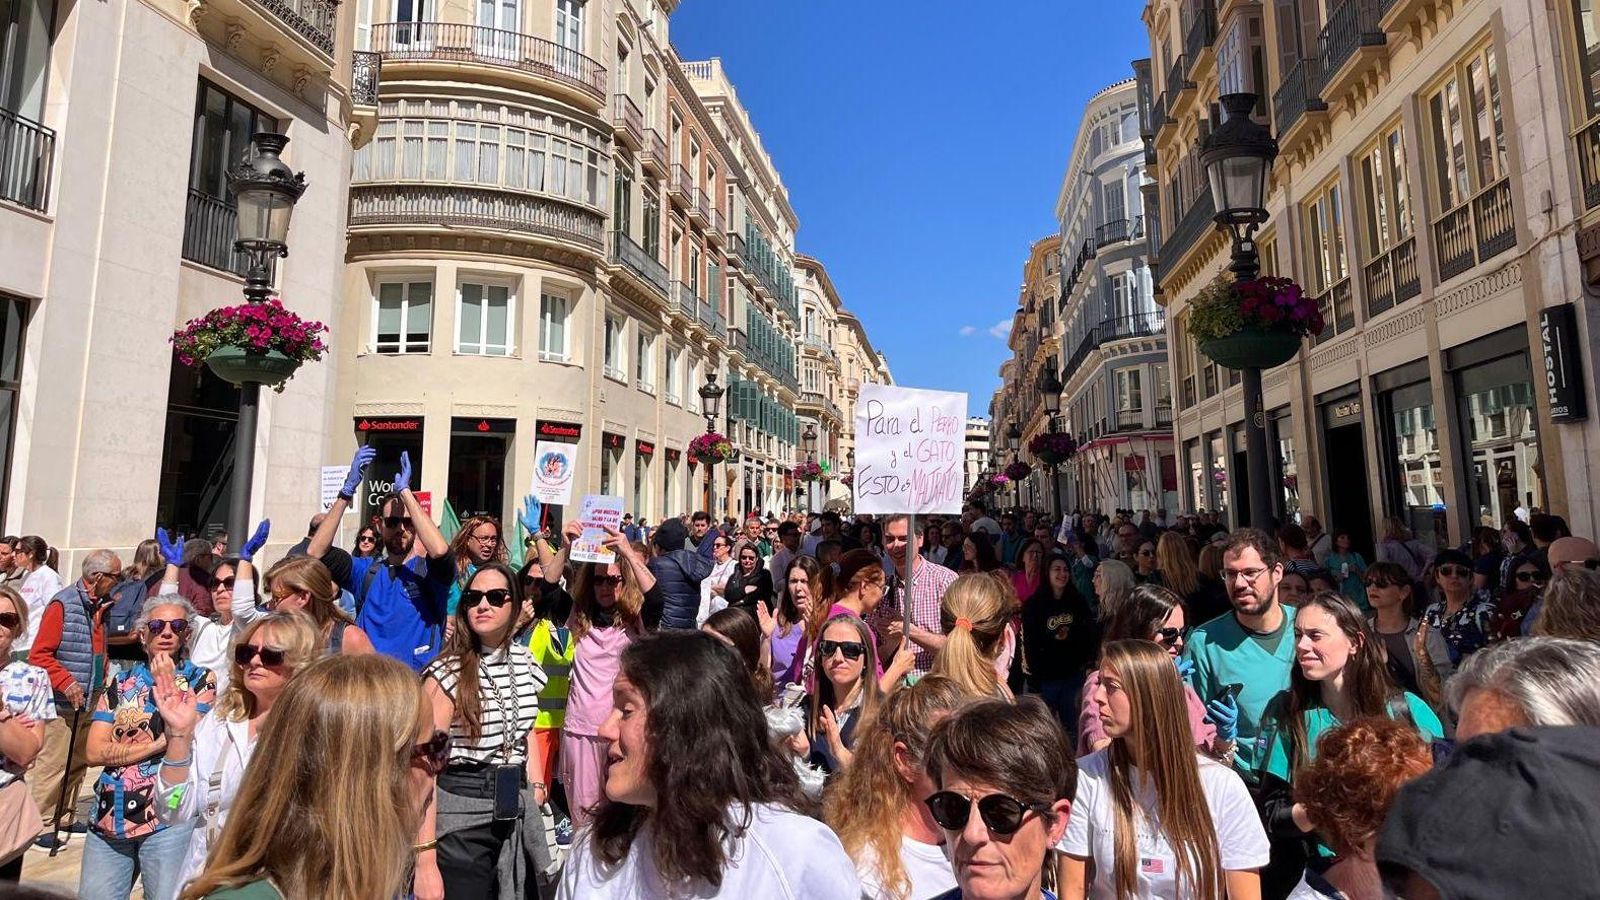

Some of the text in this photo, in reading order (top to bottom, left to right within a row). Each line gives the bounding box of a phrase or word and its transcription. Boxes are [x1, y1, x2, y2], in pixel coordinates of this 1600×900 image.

[1541, 312, 1558, 403] HOSTAL
[371, 420, 419, 430] Santander
[866, 399, 902, 436] Para
[909, 407, 924, 434] el
[890, 438, 956, 469] y el GATO
[369, 480, 396, 493] Wor
[858, 461, 959, 510] ESTO es MALTRATO
